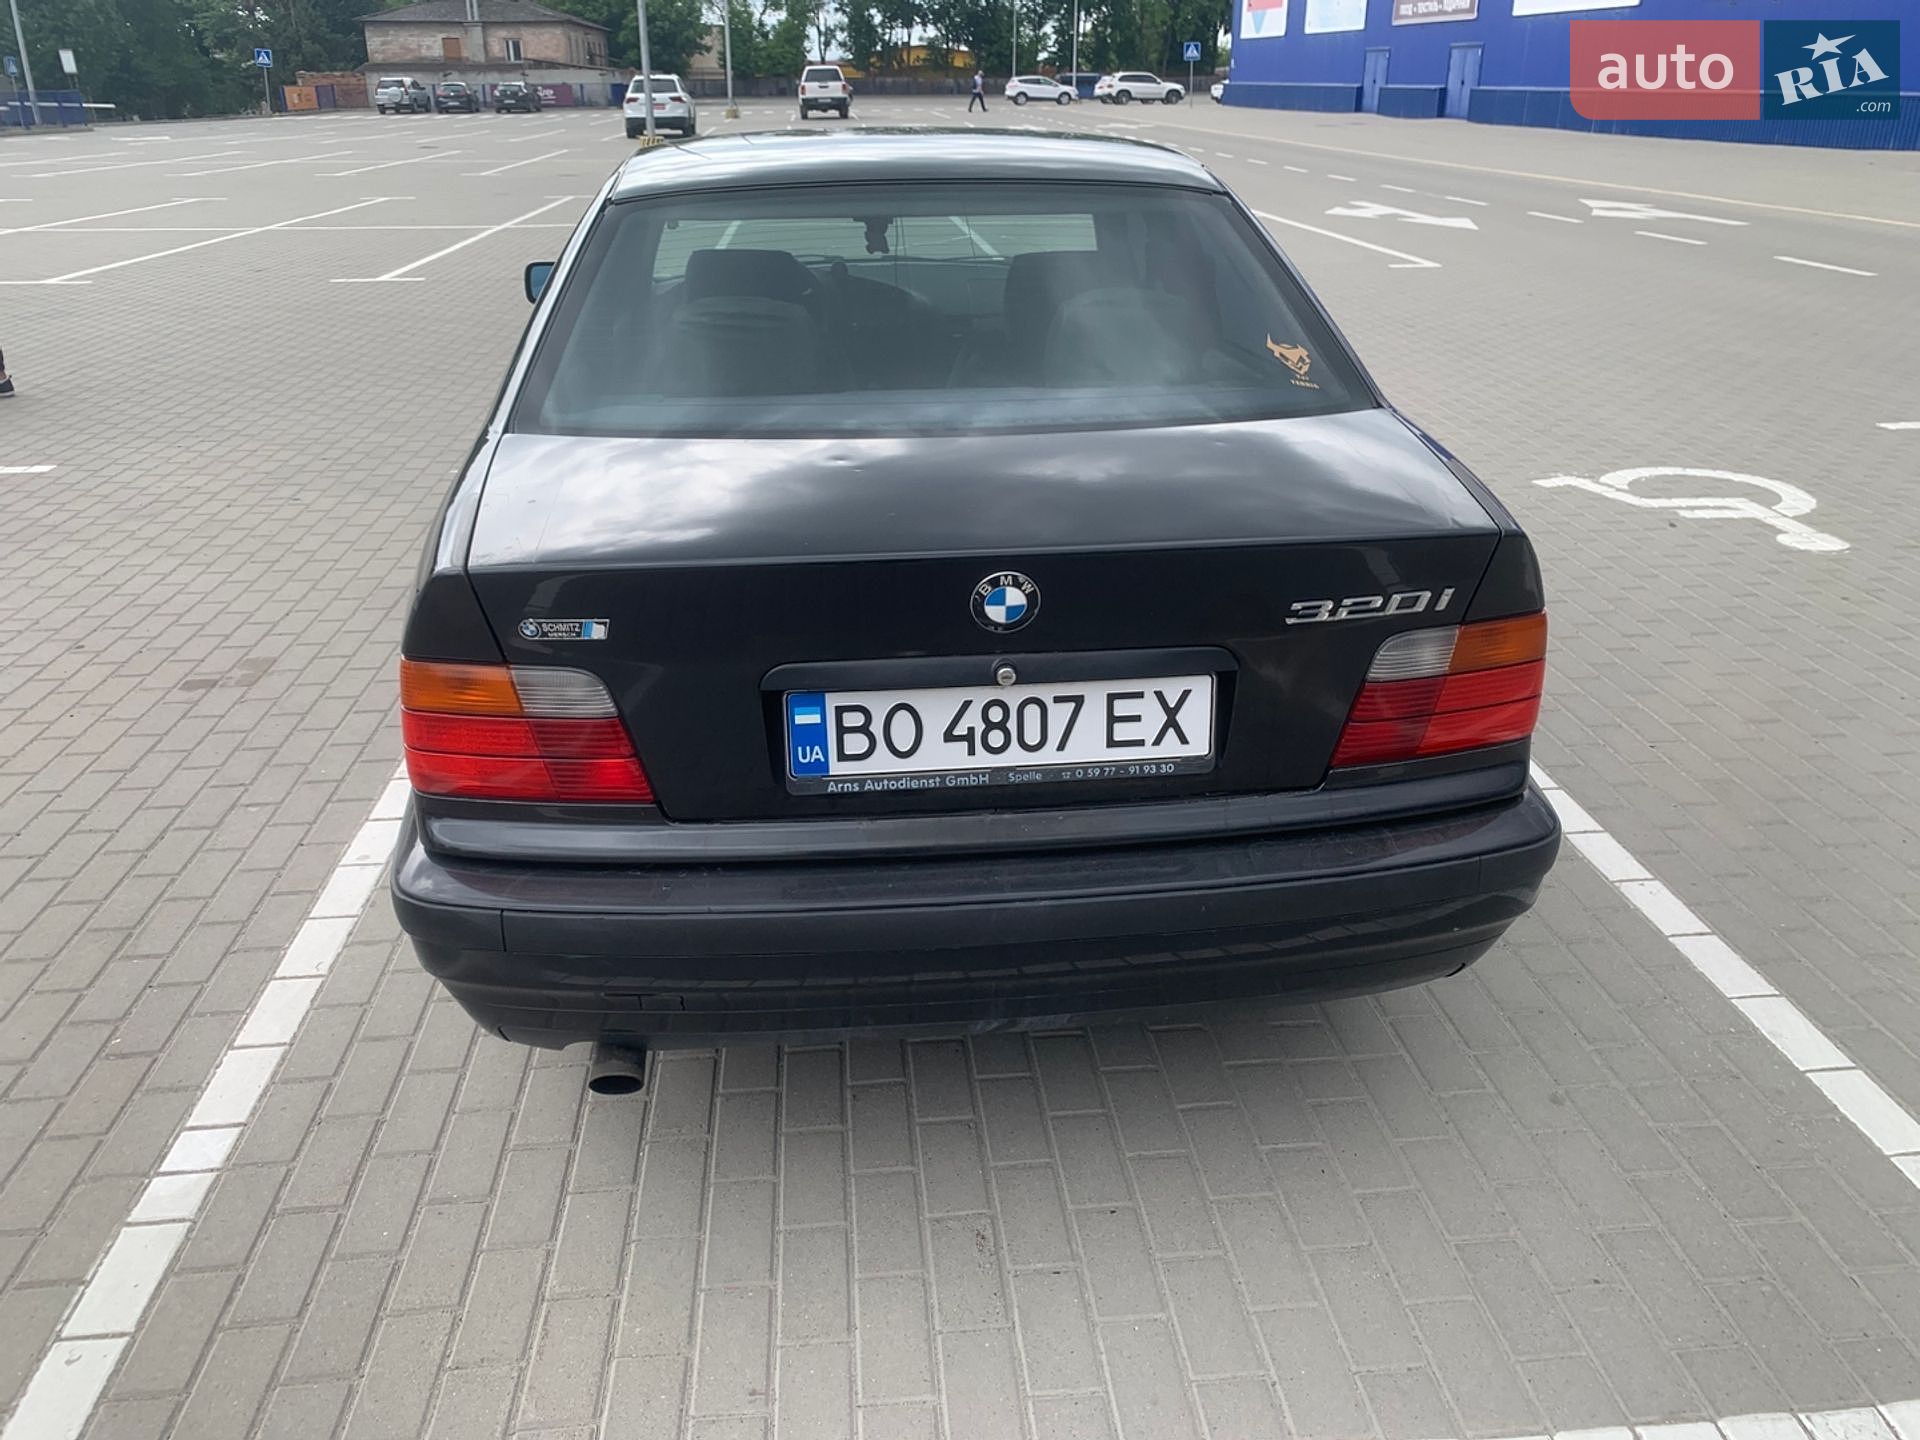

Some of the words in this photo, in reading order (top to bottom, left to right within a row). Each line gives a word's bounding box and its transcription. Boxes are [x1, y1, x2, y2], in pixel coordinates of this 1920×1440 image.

[978, 575, 1035, 596] BMW
[542, 622, 581, 632] SCHMITZ
[833, 702, 924, 763] BO
[942, 694, 1085, 756] 4807
[1105, 688, 1193, 749] EX
[798, 745, 825, 763] UA
[827, 781, 860, 793] Arns
[864, 776, 940, 790] Autodienst
[945, 773, 989, 786] GmbH
[1008, 770, 1042, 783] Spelle
[1128, 765, 1140, 775] 91
[1143, 764, 1156, 774] 93
[1160, 763, 1174, 773] 30
